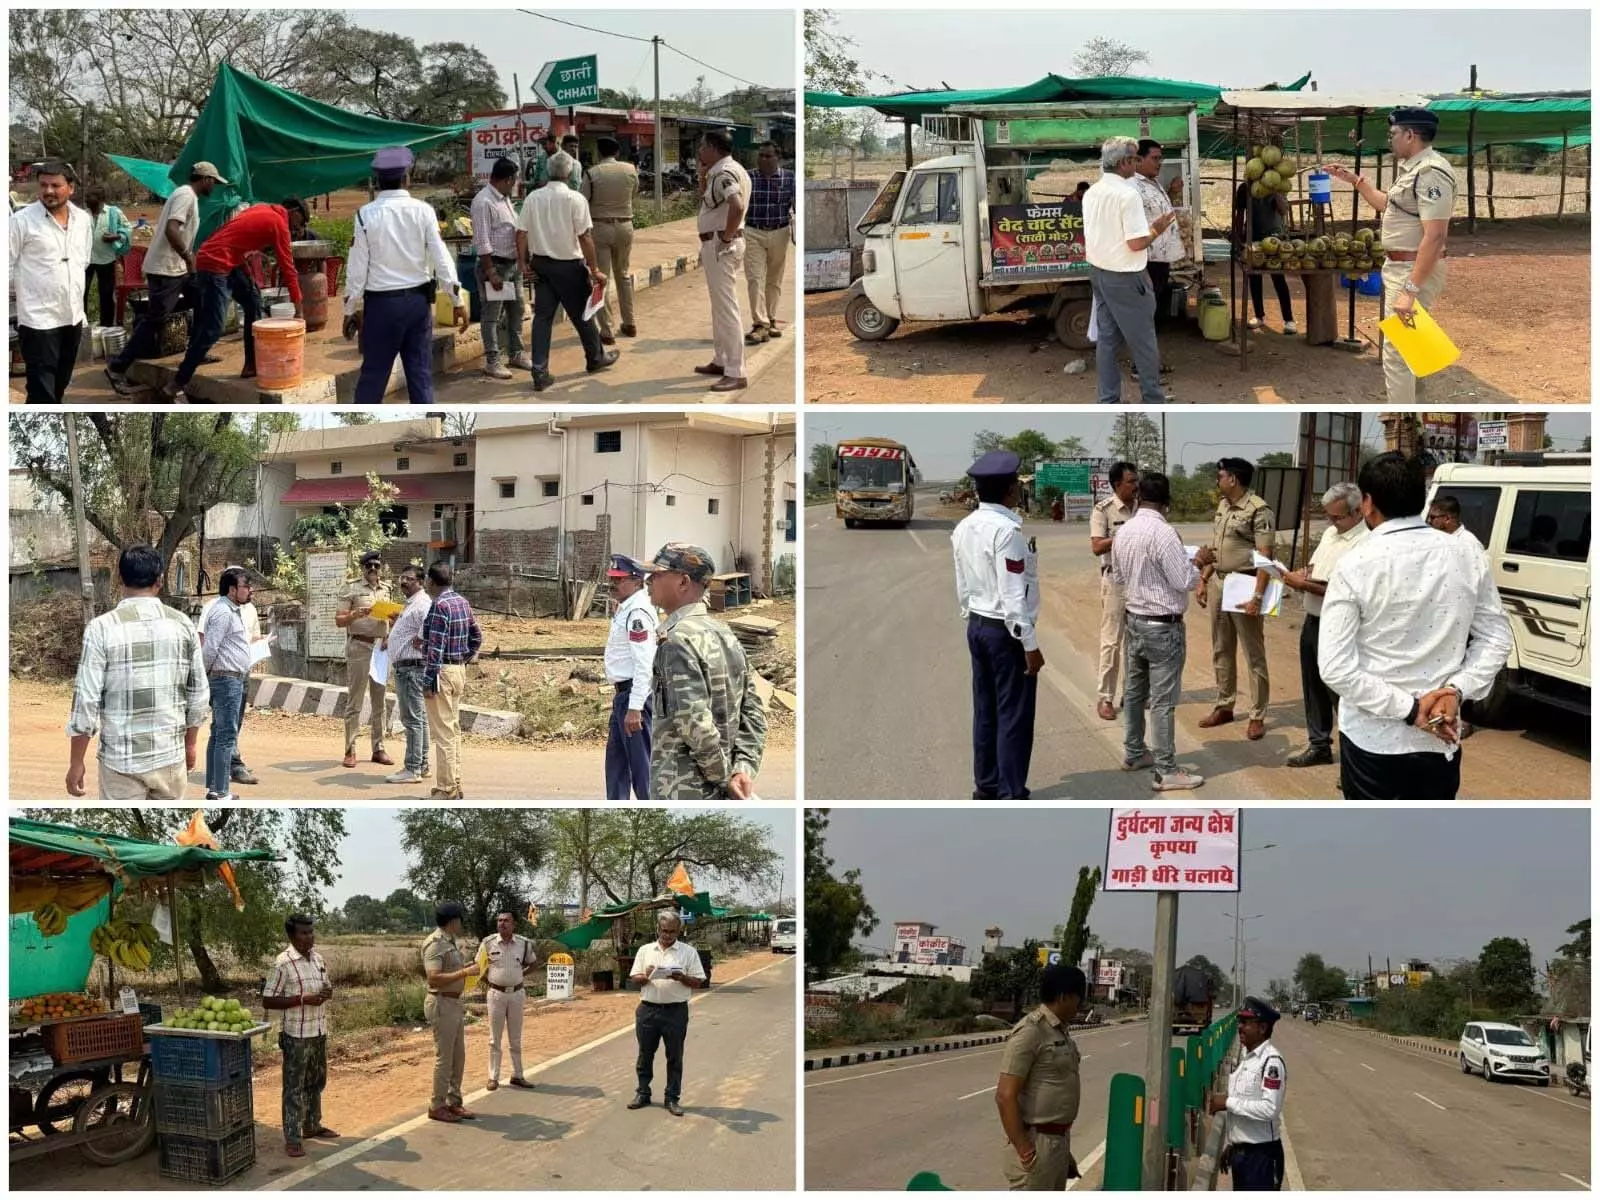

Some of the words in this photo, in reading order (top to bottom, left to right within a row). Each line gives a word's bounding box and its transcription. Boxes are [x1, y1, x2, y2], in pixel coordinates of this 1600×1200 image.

[560, 61, 592, 82] छाती
[557, 84, 597, 100] CHHATI
[1025, 205, 1063, 218] फेमस
[998, 217, 1023, 232] वेद
[1027, 219, 1056, 231] चाट
[1060, 214, 1084, 230] सेंट
[1117, 811, 1166, 841] दुर्घटना
[1171, 815, 1204, 833] जन्य
[1208, 811, 1234, 833] क्षेत्र
[1150, 841, 1198, 859] कृपया
[1112, 865, 1146, 887] गाड़ी
[1152, 865, 1179, 883] धीरे
[1185, 865, 1233, 883] चलाये
